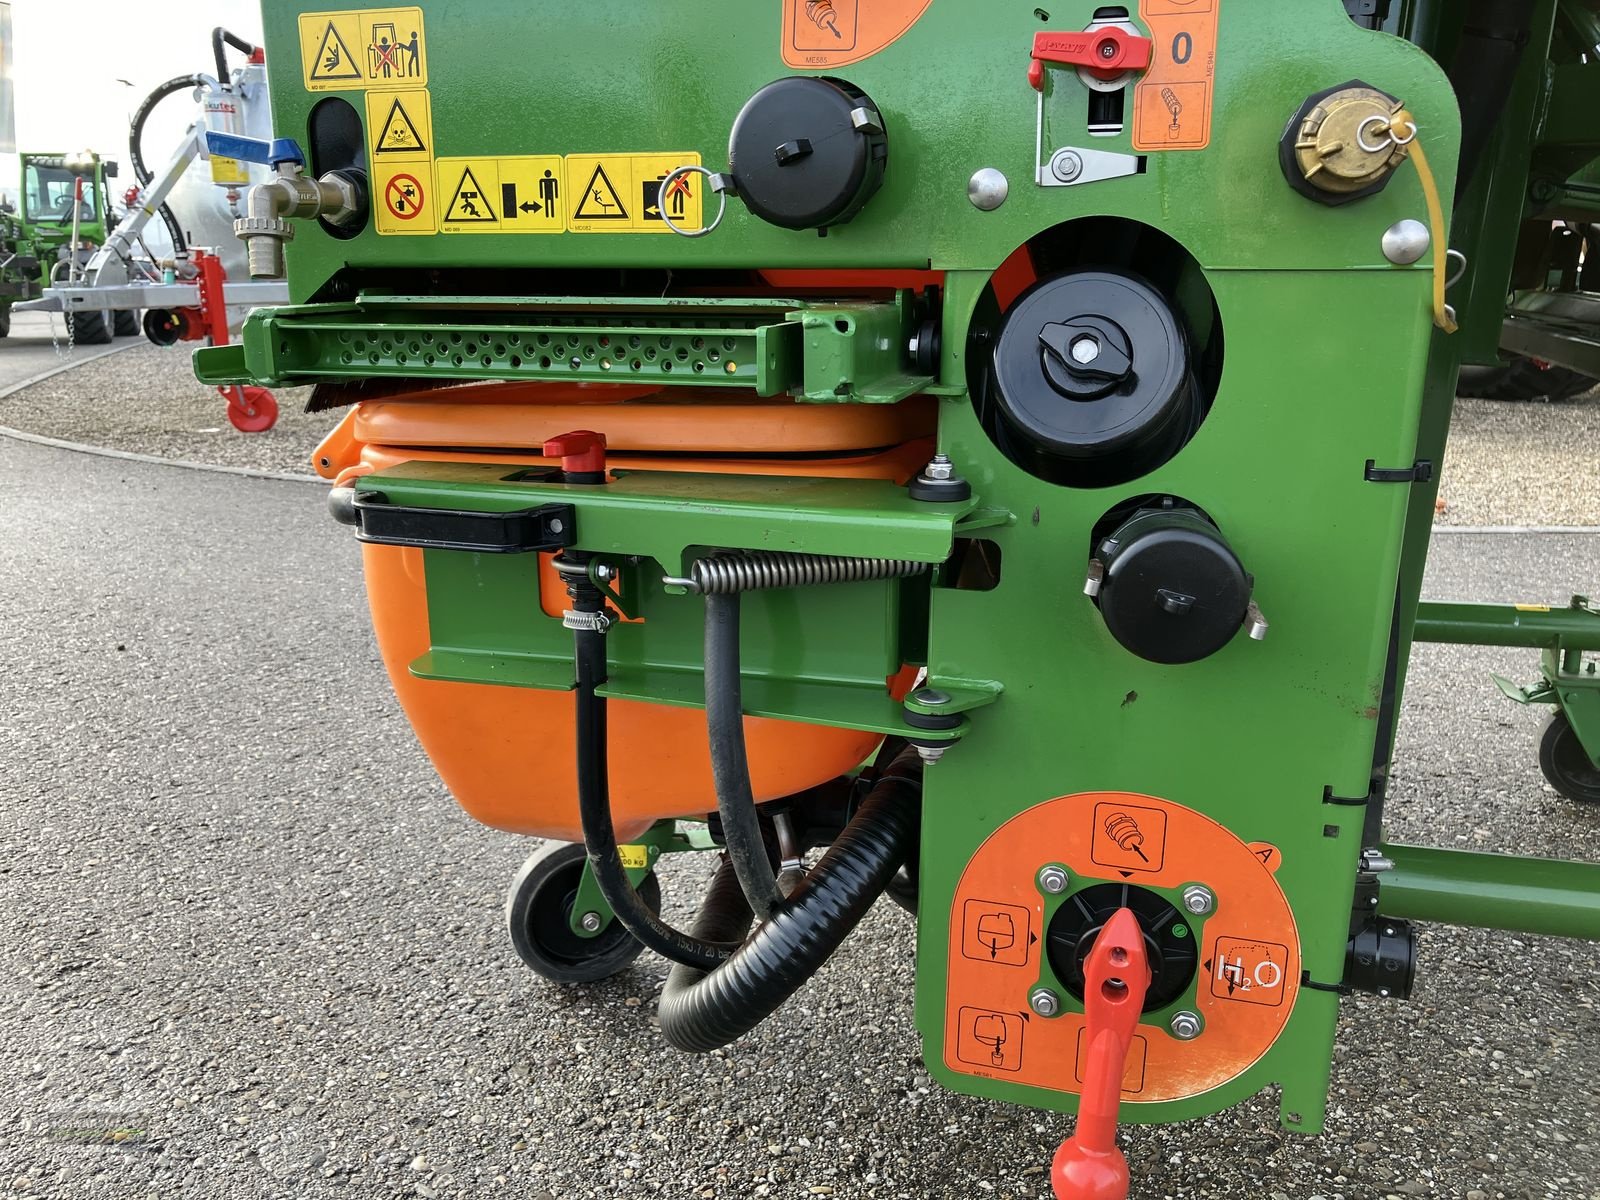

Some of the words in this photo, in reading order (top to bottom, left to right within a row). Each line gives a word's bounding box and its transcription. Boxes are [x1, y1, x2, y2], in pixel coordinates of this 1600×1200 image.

[1171, 31, 1193, 65] 0
[633, 859, 644, 867] kg
[1255, 848, 1273, 864] A
[705, 945, 715, 958] 20
